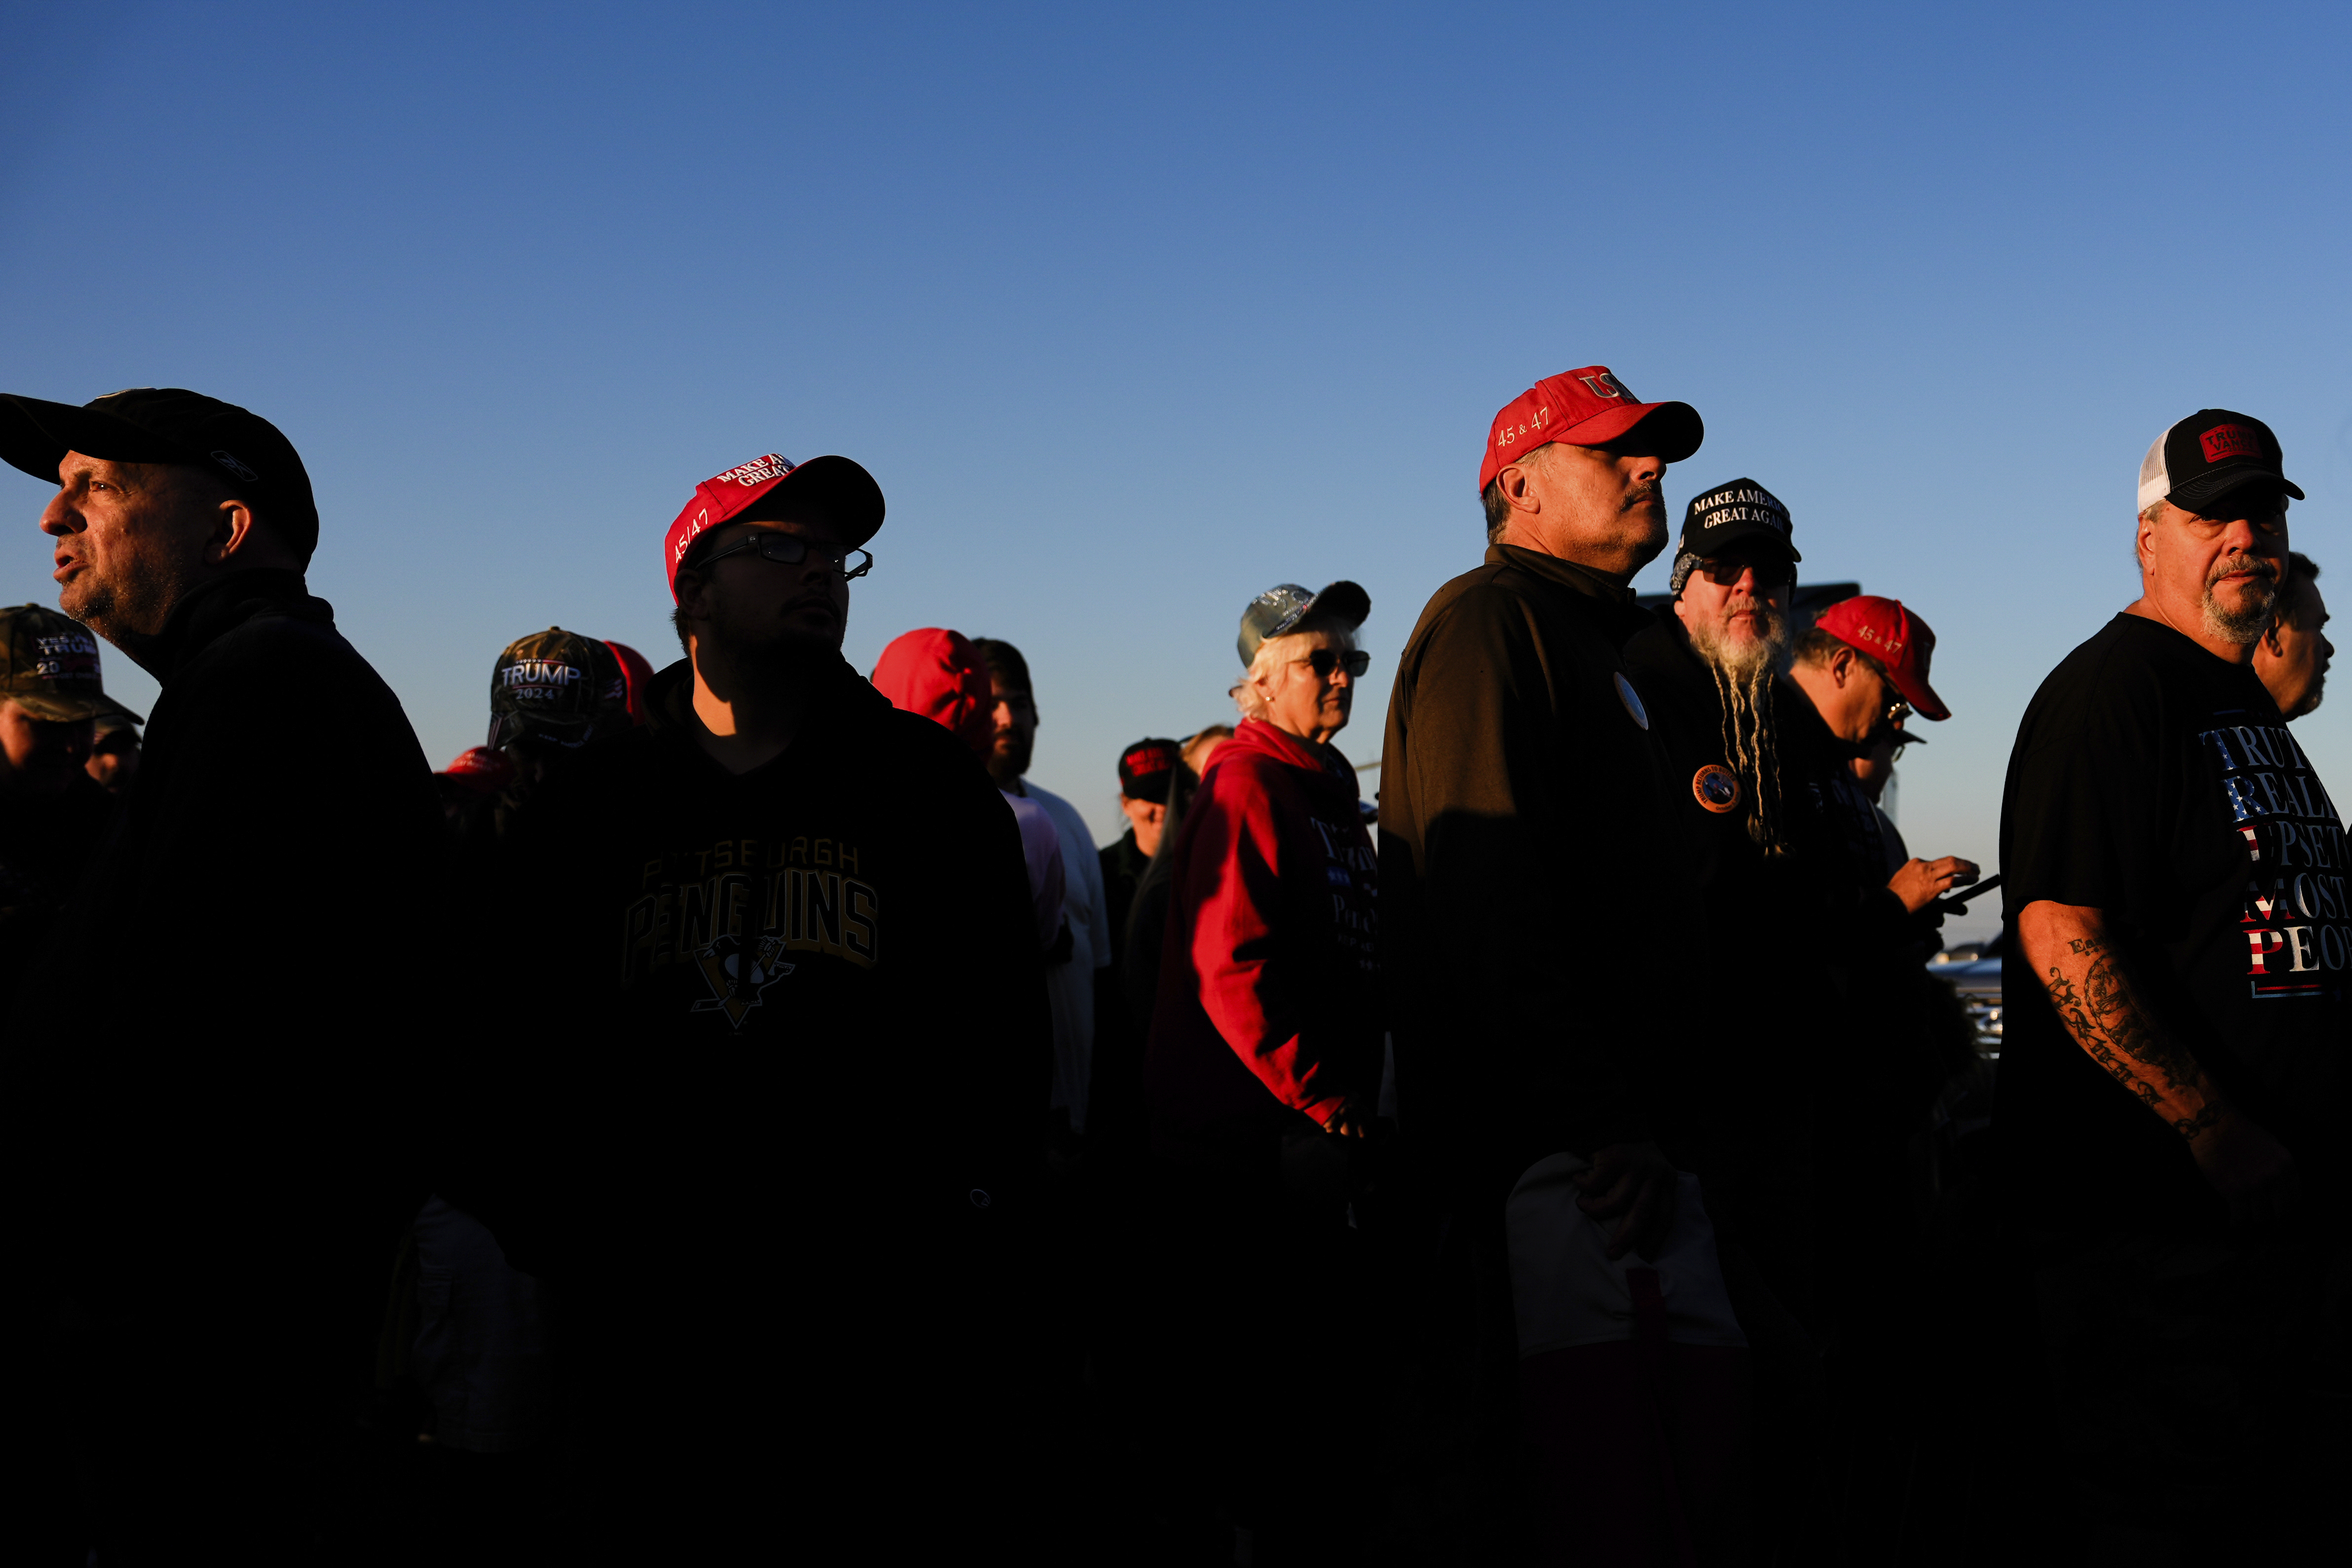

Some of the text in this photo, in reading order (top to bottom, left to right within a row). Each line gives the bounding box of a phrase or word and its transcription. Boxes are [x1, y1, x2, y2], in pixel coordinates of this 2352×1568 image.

[1498, 406, 1549, 447] 45 & 47
[717, 459, 769, 483] MAKE
[1694, 490, 1735, 515] MAKE
[1704, 507, 1748, 529] GREAT
[675, 507, 708, 564] 45/47
[1858, 625, 1876, 641] 45
[1884, 639, 1902, 654] 47
[501, 663, 582, 687] TRUMP
[516, 688, 556, 700] 2024
[2198, 726, 2315, 771] TRUT
[2240, 872, 2351, 923] MOST
